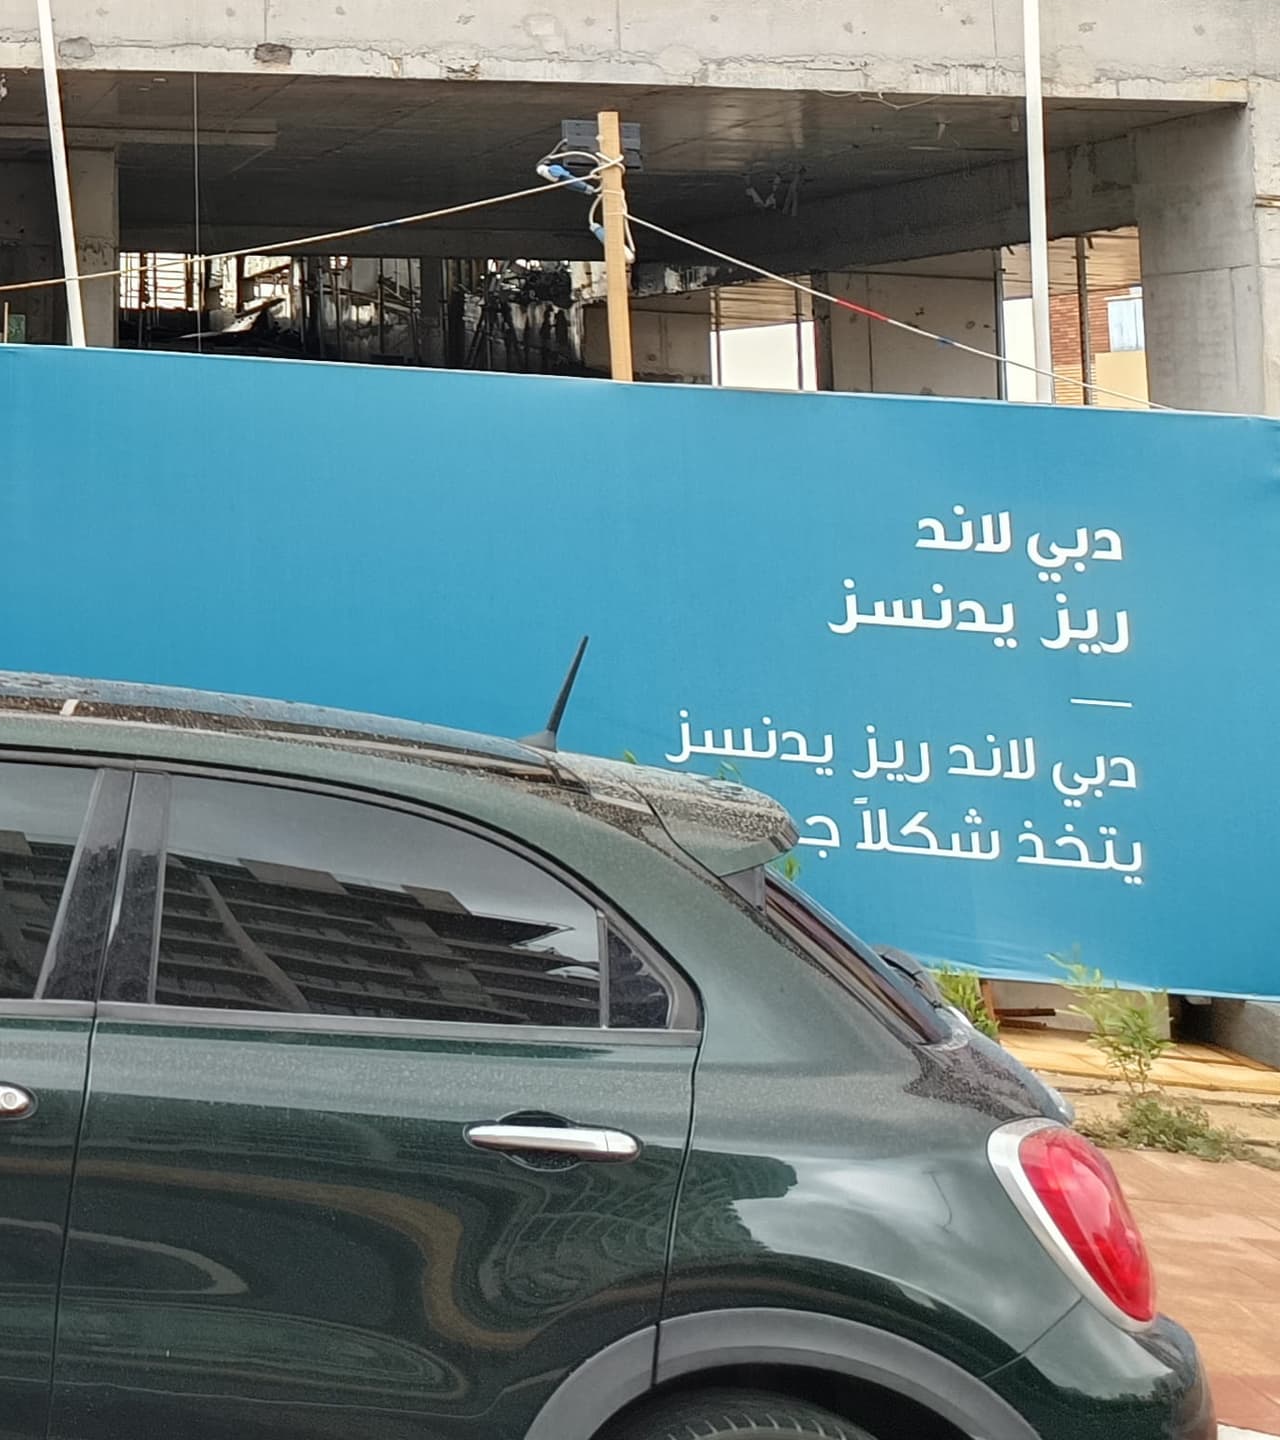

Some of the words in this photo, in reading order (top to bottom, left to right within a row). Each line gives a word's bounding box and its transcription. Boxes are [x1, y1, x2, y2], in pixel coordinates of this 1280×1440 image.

[915, 505, 1012, 554] لاند
[1026, 526, 1124, 583] دبي
[947, 733, 1036, 780] لاند
[1052, 754, 1137, 808] دبي
[1015, 820, 1144, 886] يتخذ
